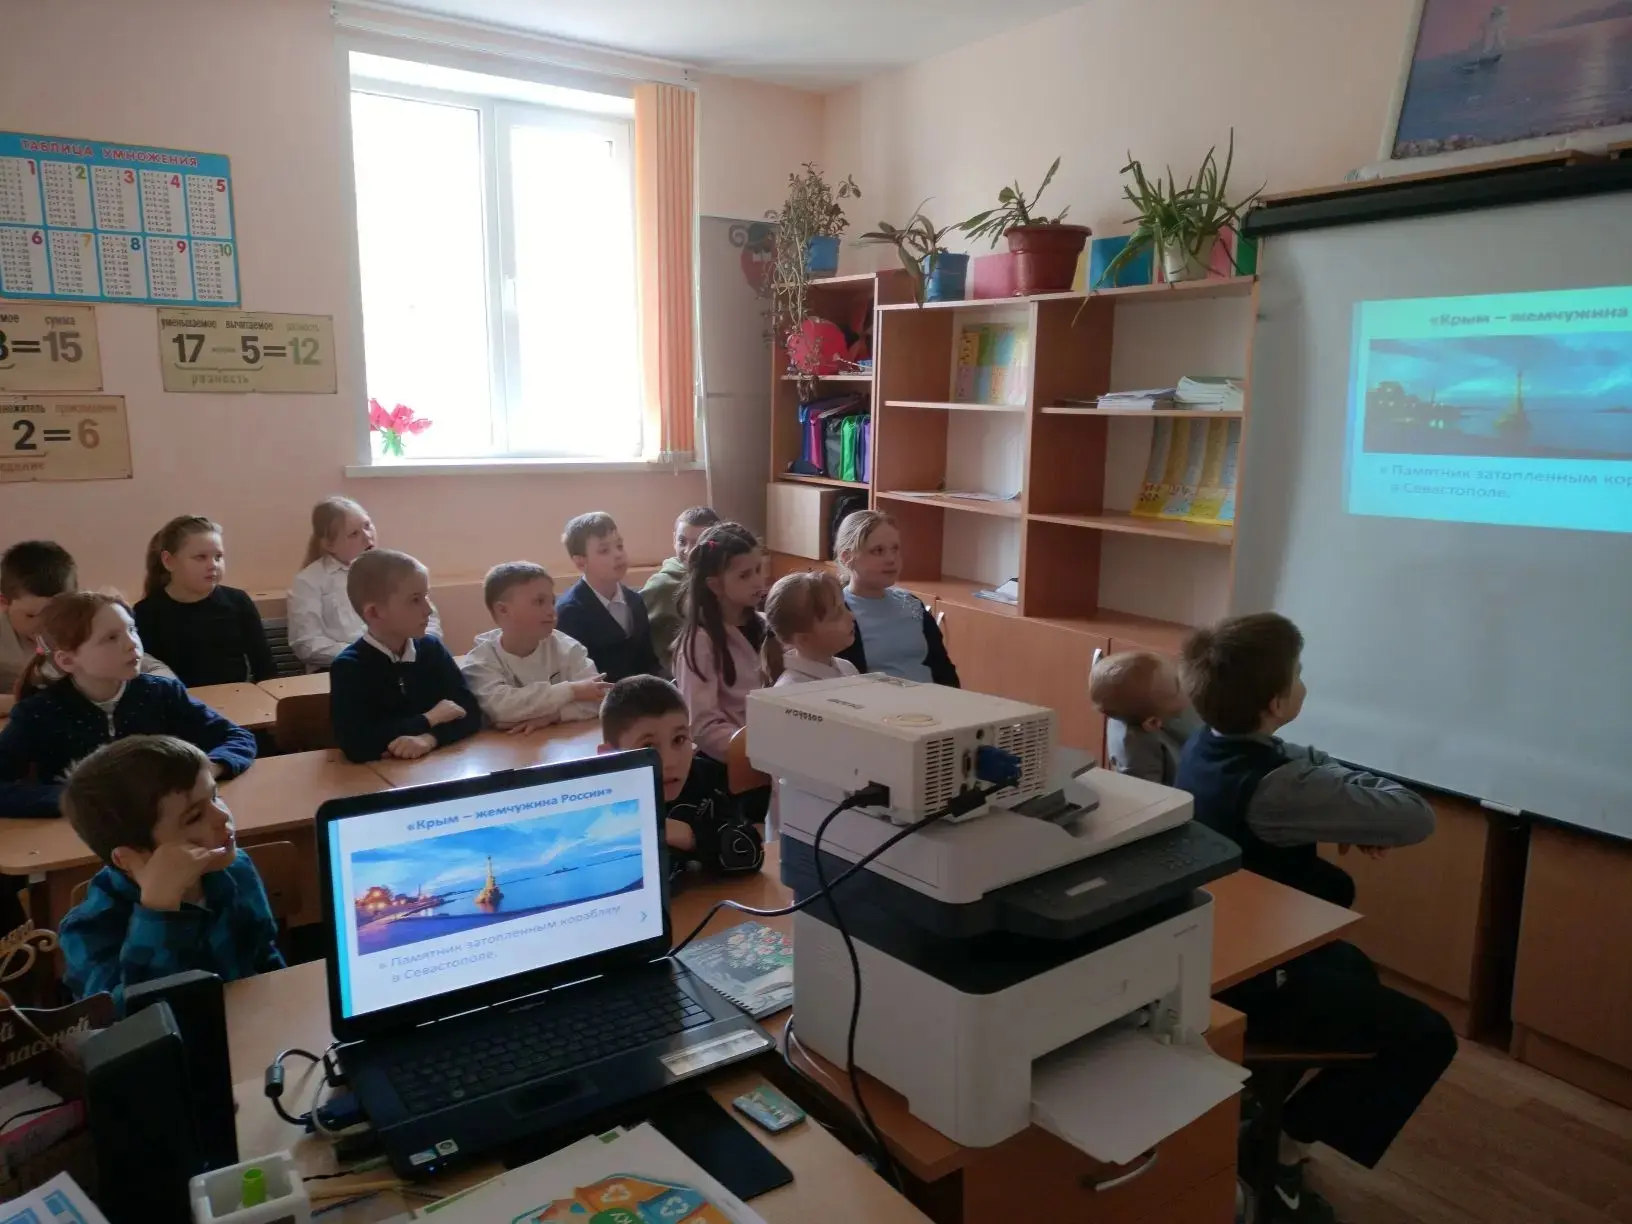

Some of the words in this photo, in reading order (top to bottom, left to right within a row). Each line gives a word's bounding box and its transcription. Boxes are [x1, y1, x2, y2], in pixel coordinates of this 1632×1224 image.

[21, 139, 94, 157] ТАБЛИЦА
[103, 148, 198, 167] УМНОЖЕНИЯ
[27, 160, 36, 175] 1
[75, 166, 87, 180] 2
[124, 170, 135, 184] 3
[170, 175, 181, 189] 4
[216, 179, 226, 193] 5
[31, 231, 43, 245] 6
[80, 233, 93, 248] 7
[130, 237, 141, 250] 8
[176, 240, 187, 253] 9
[219, 244, 232, 257] 10
[1509, 306, 1629, 323] жемчужина
[45, 316, 76, 329] сумма
[225, 319, 274, 331] вычитаемое
[172, 333, 205, 363] 17
[192, 374, 249, 387] разность
[12, 419, 37, 450] 2
[78, 418, 100, 449] 6
[1392, 464, 1471, 480] Памятник
[1477, 470, 1598, 485] затопленным
[475, 797, 558, 820] жемчужина
[391, 942, 463, 968] Памятник
[465, 920, 557, 950] затопленным
